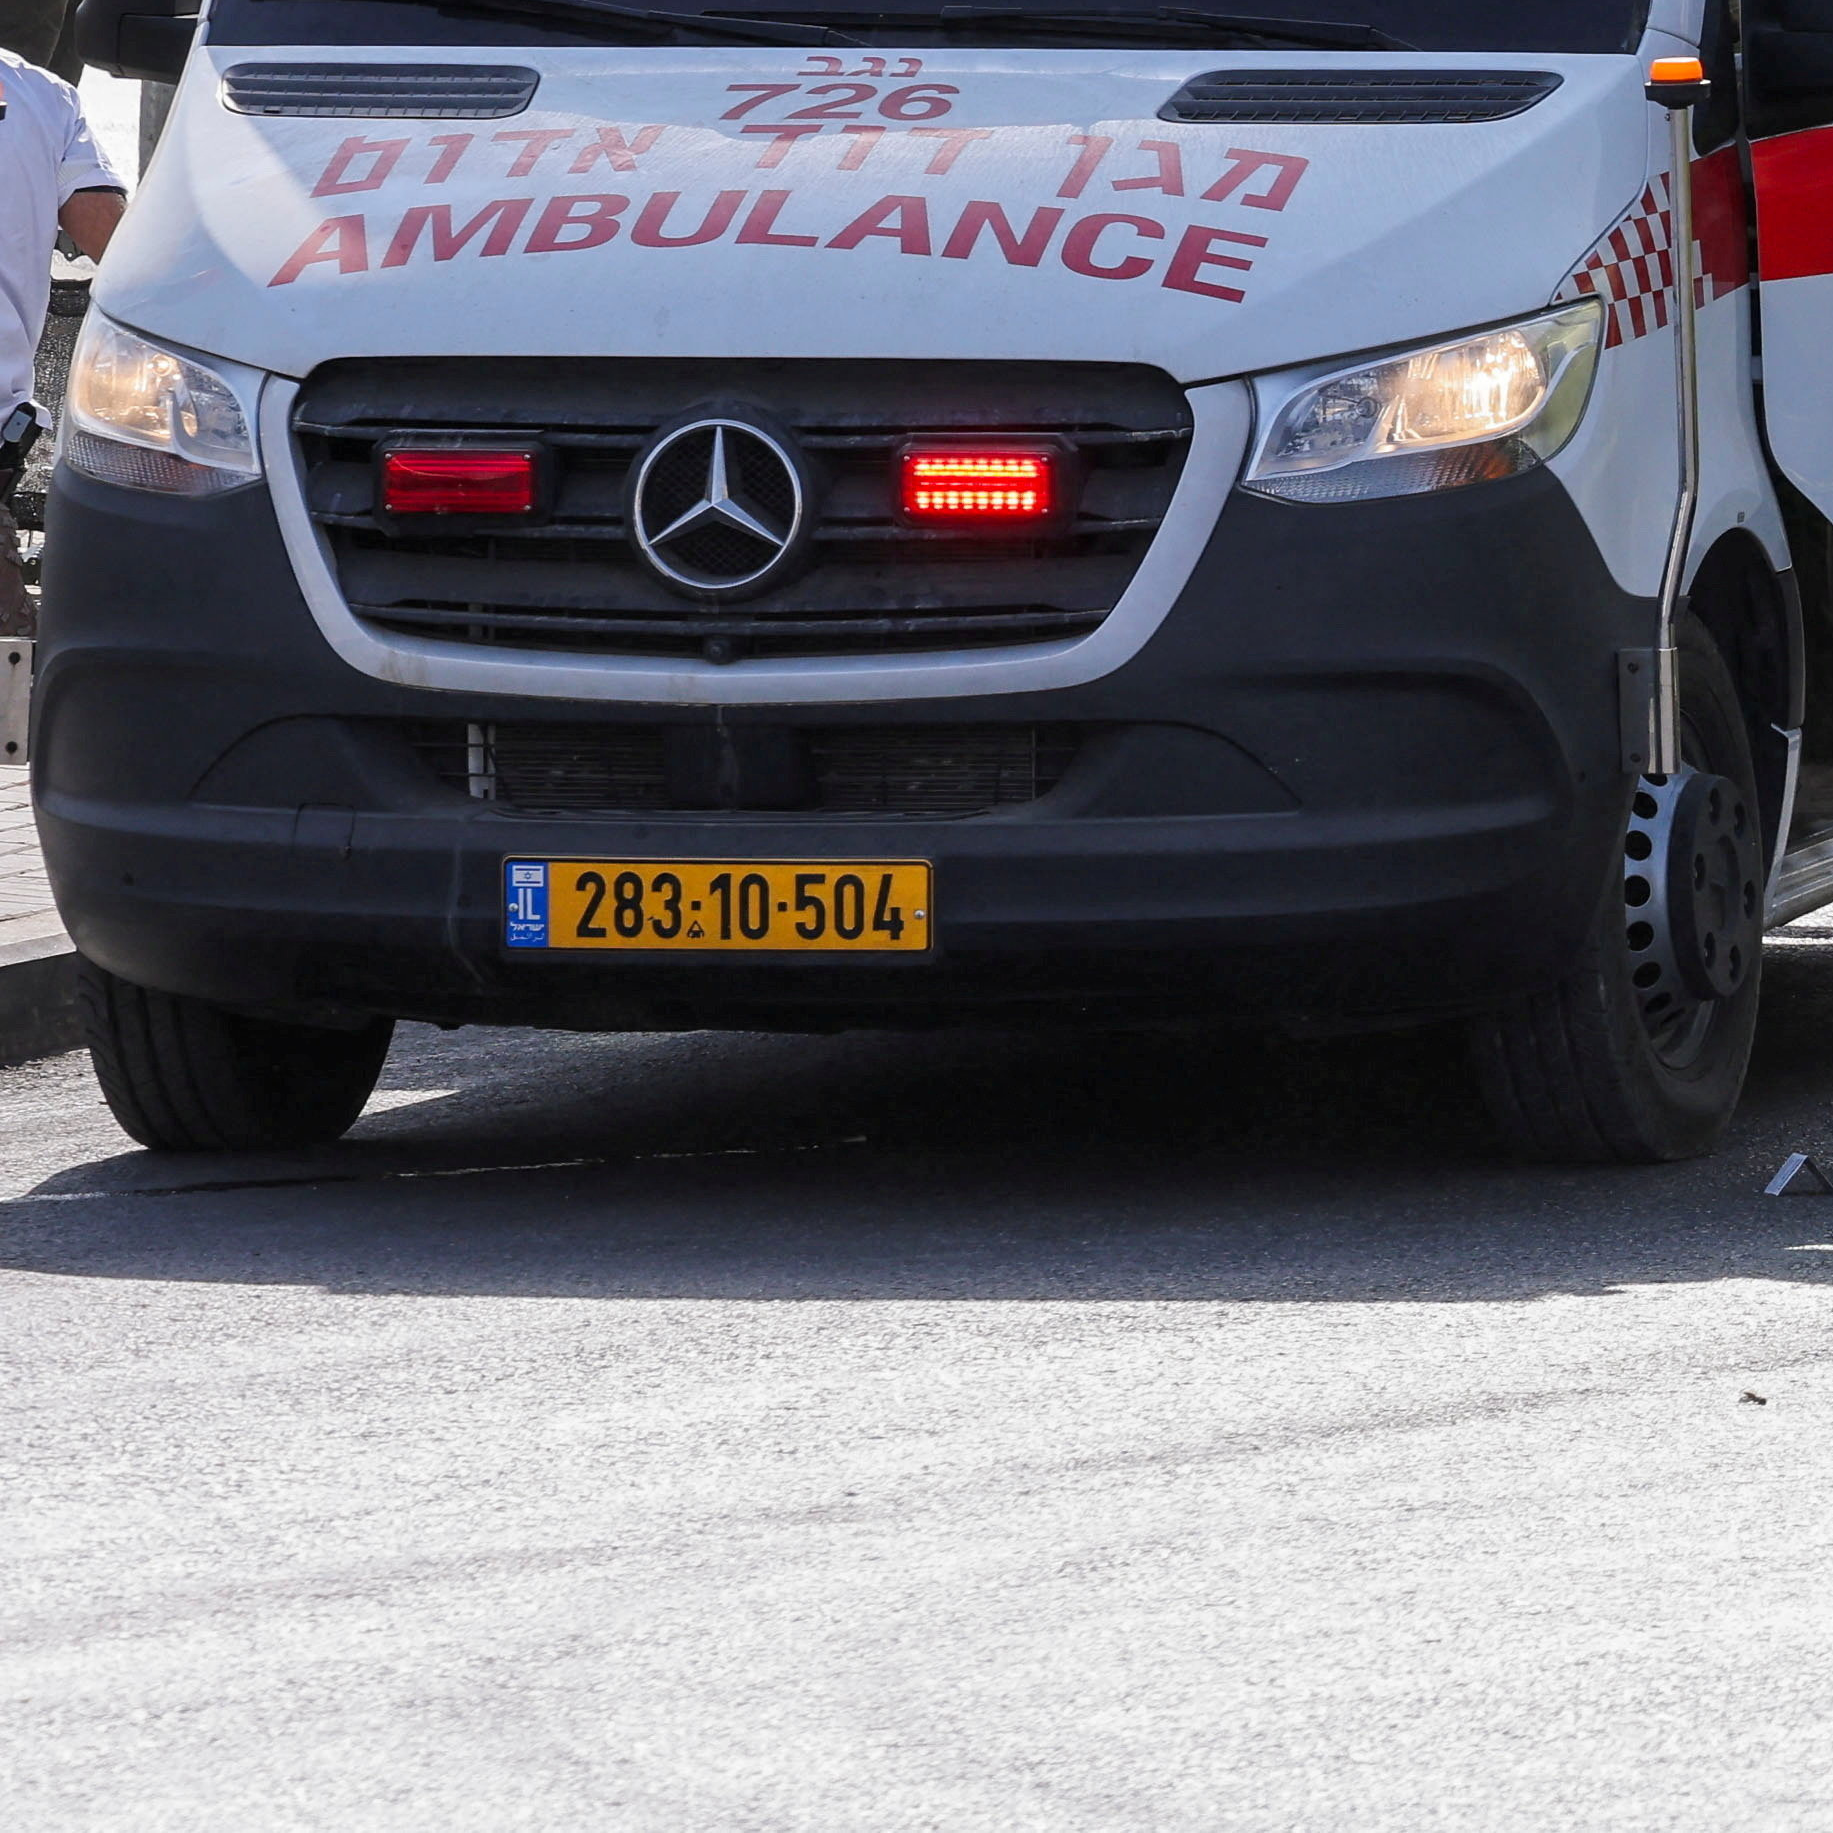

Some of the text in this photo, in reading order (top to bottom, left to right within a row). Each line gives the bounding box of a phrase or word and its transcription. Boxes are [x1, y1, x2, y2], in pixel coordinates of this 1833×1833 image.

[795, 55, 923, 79] נגב
[720, 82, 961, 121] 726
[310, 123, 1309, 213] מגן דוד אדום
[267, 189, 1269, 304] AMBULANCE
[518, 888, 541, 921] IL
